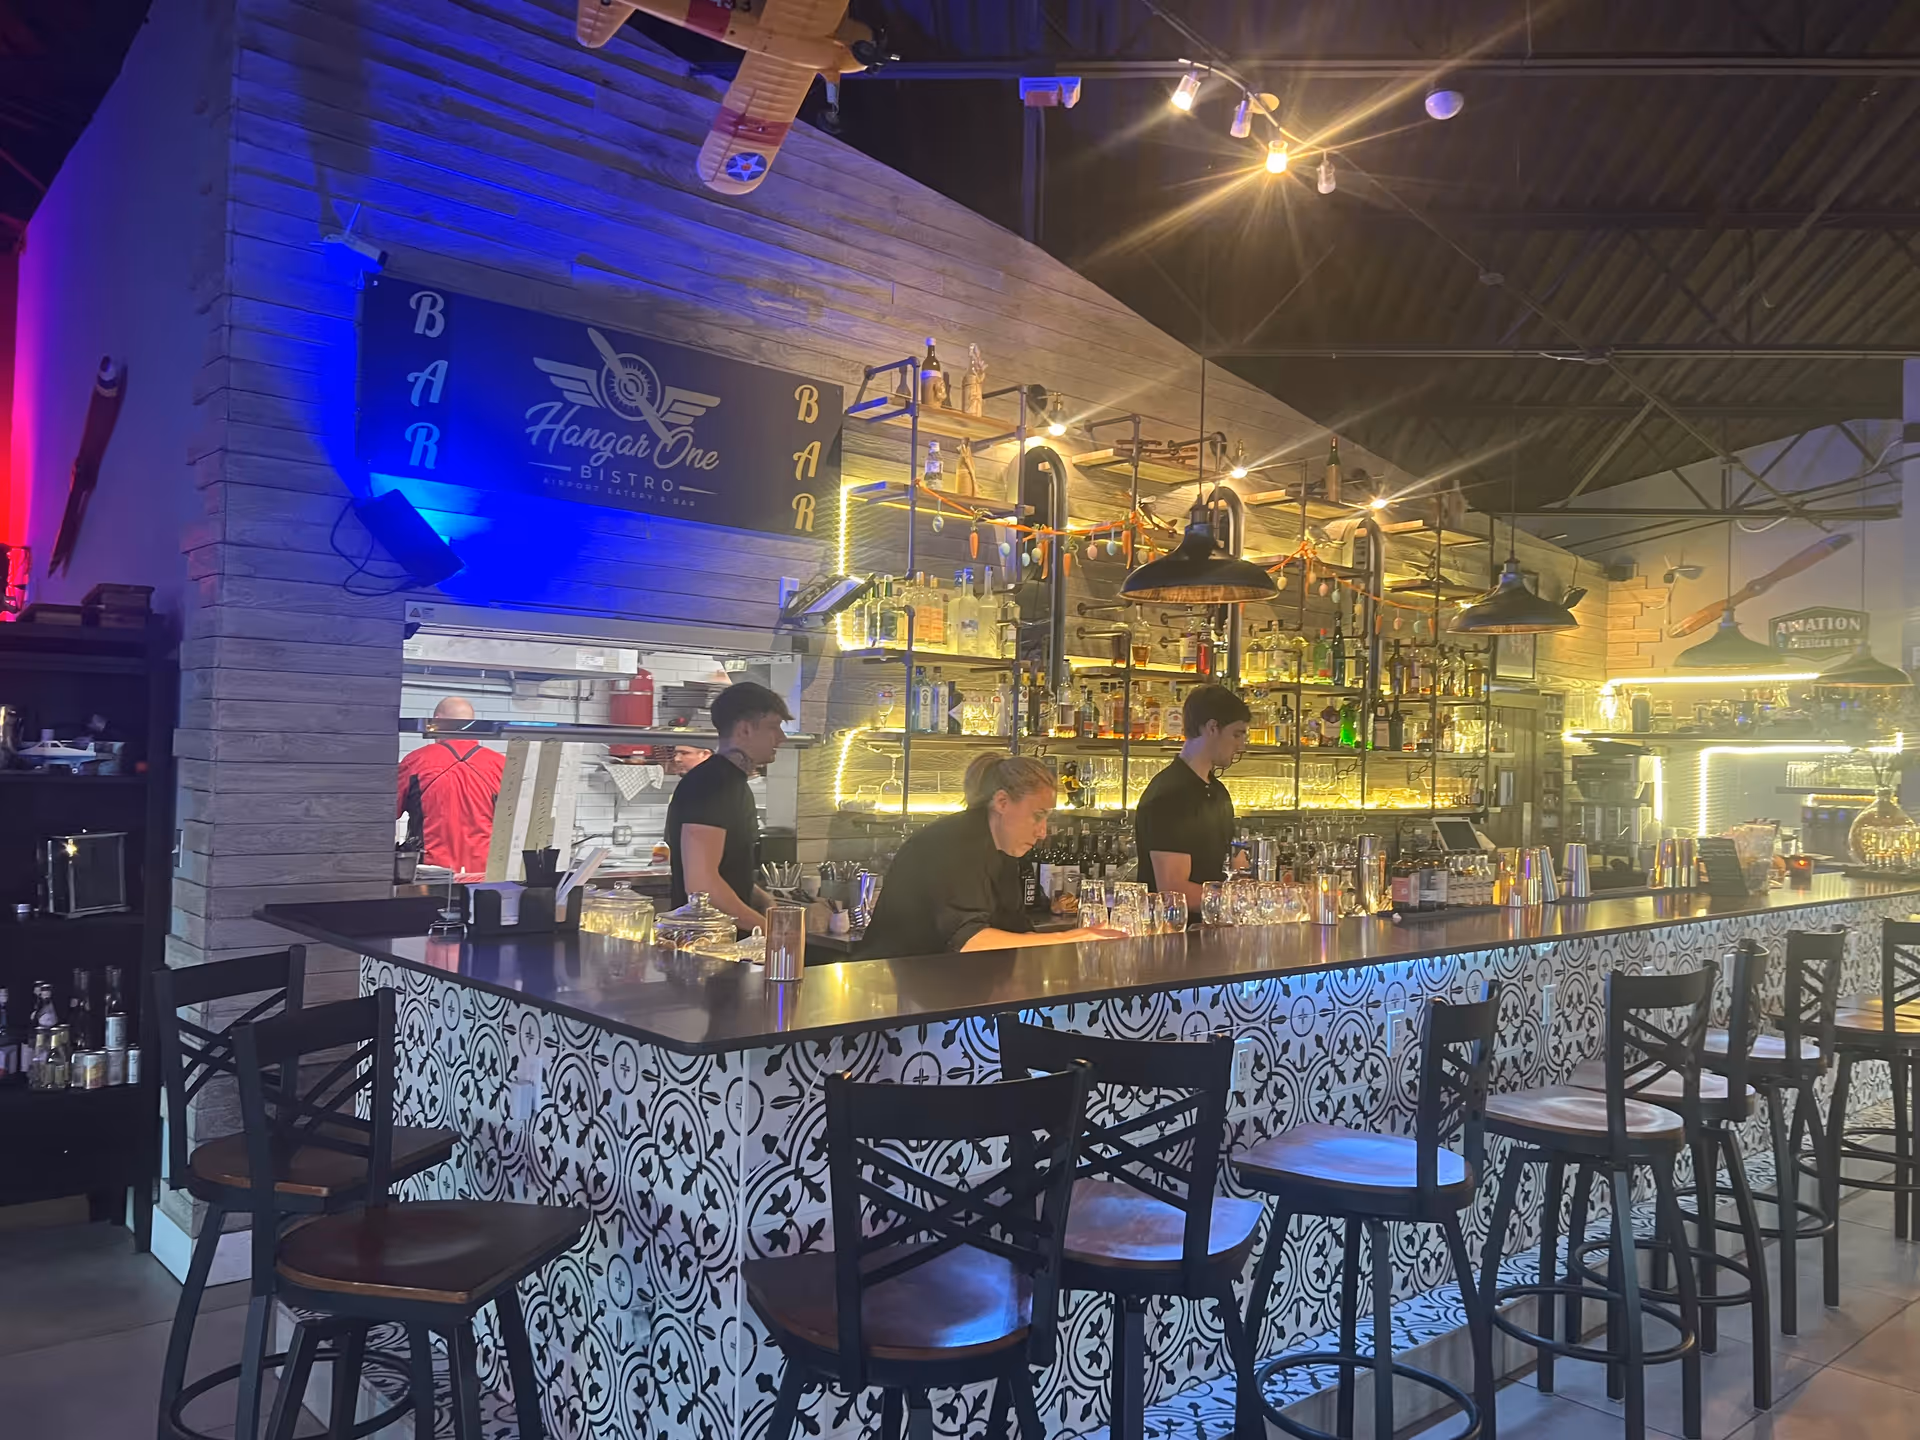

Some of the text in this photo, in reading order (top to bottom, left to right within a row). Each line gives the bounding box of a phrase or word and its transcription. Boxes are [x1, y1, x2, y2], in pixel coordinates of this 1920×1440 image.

[404, 290, 448, 470] BAR
[525, 401, 720, 471] Hangar One
[792, 384, 823, 533] BAR
[580, 465, 674, 492] BISTRO
[1775, 617, 1860, 635] AVIATION
